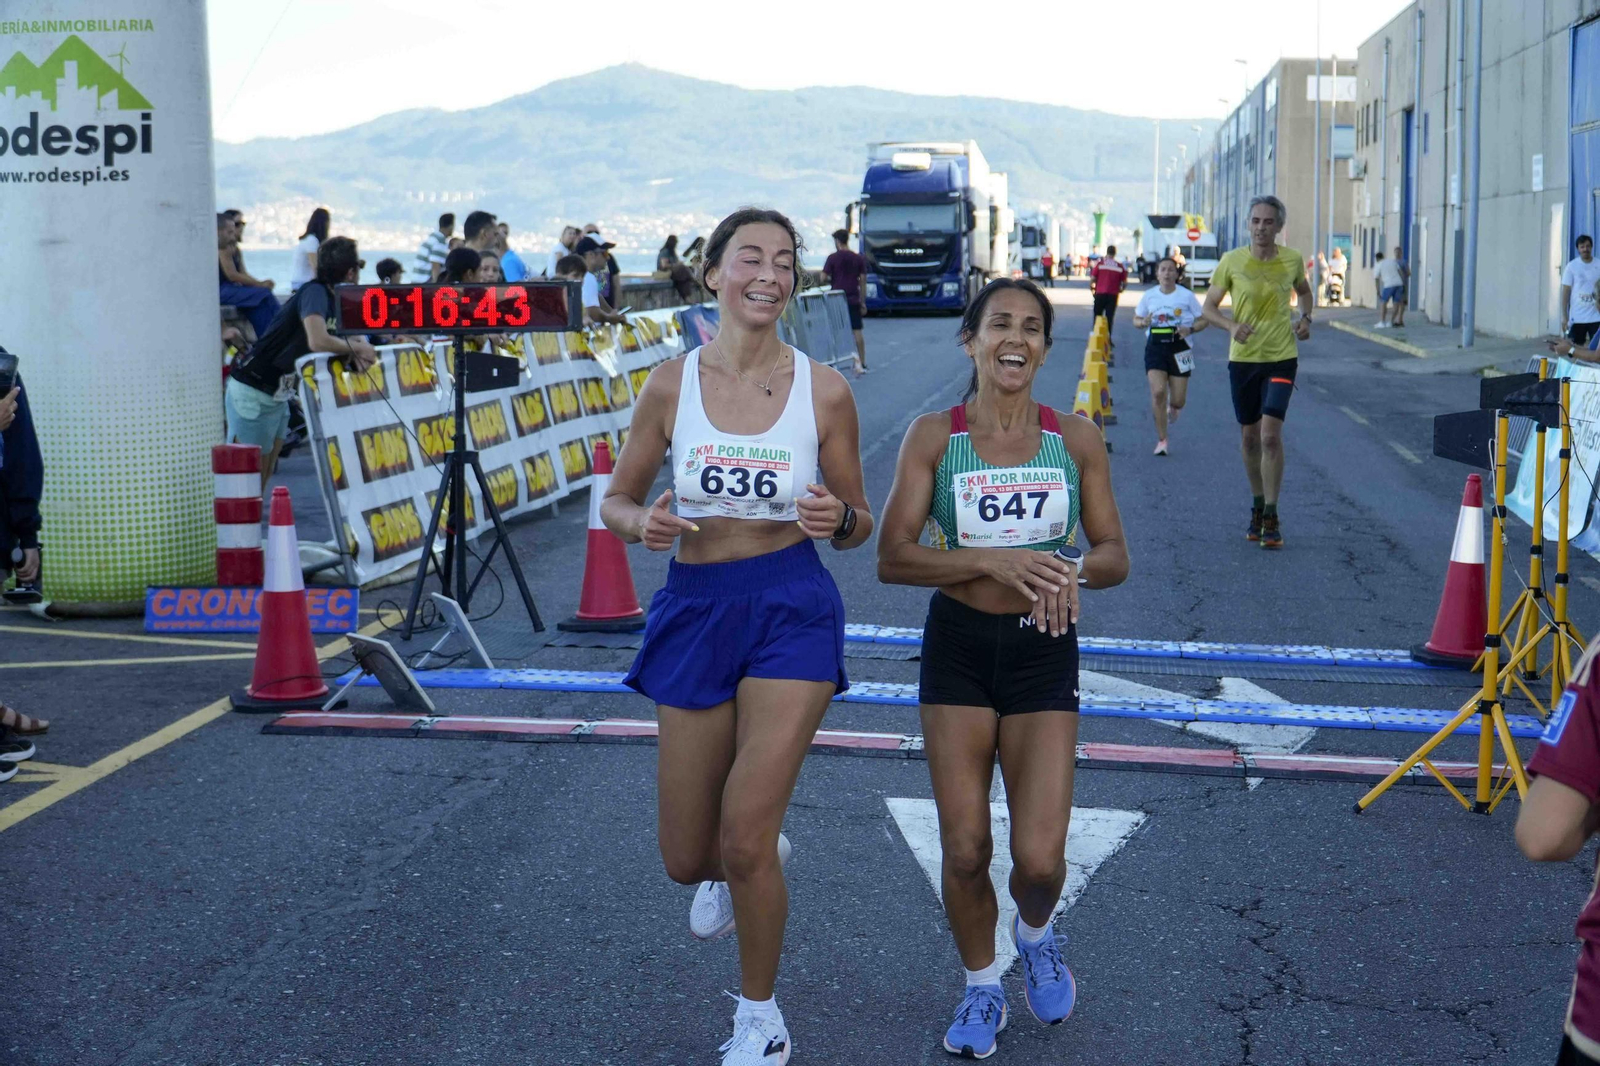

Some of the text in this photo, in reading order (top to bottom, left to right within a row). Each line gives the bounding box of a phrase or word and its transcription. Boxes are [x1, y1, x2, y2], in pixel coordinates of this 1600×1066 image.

[361, 285, 531, 328] 0:16:43
[689, 445, 791, 462] 5KM POR MAURI
[707, 457, 722, 465] VIGO,
[738, 460, 768, 468] SETEMBRO
[700, 465, 778, 499] 636
[960, 471, 1063, 488] 5KM POR MAURI
[978, 491, 1049, 523] 647
